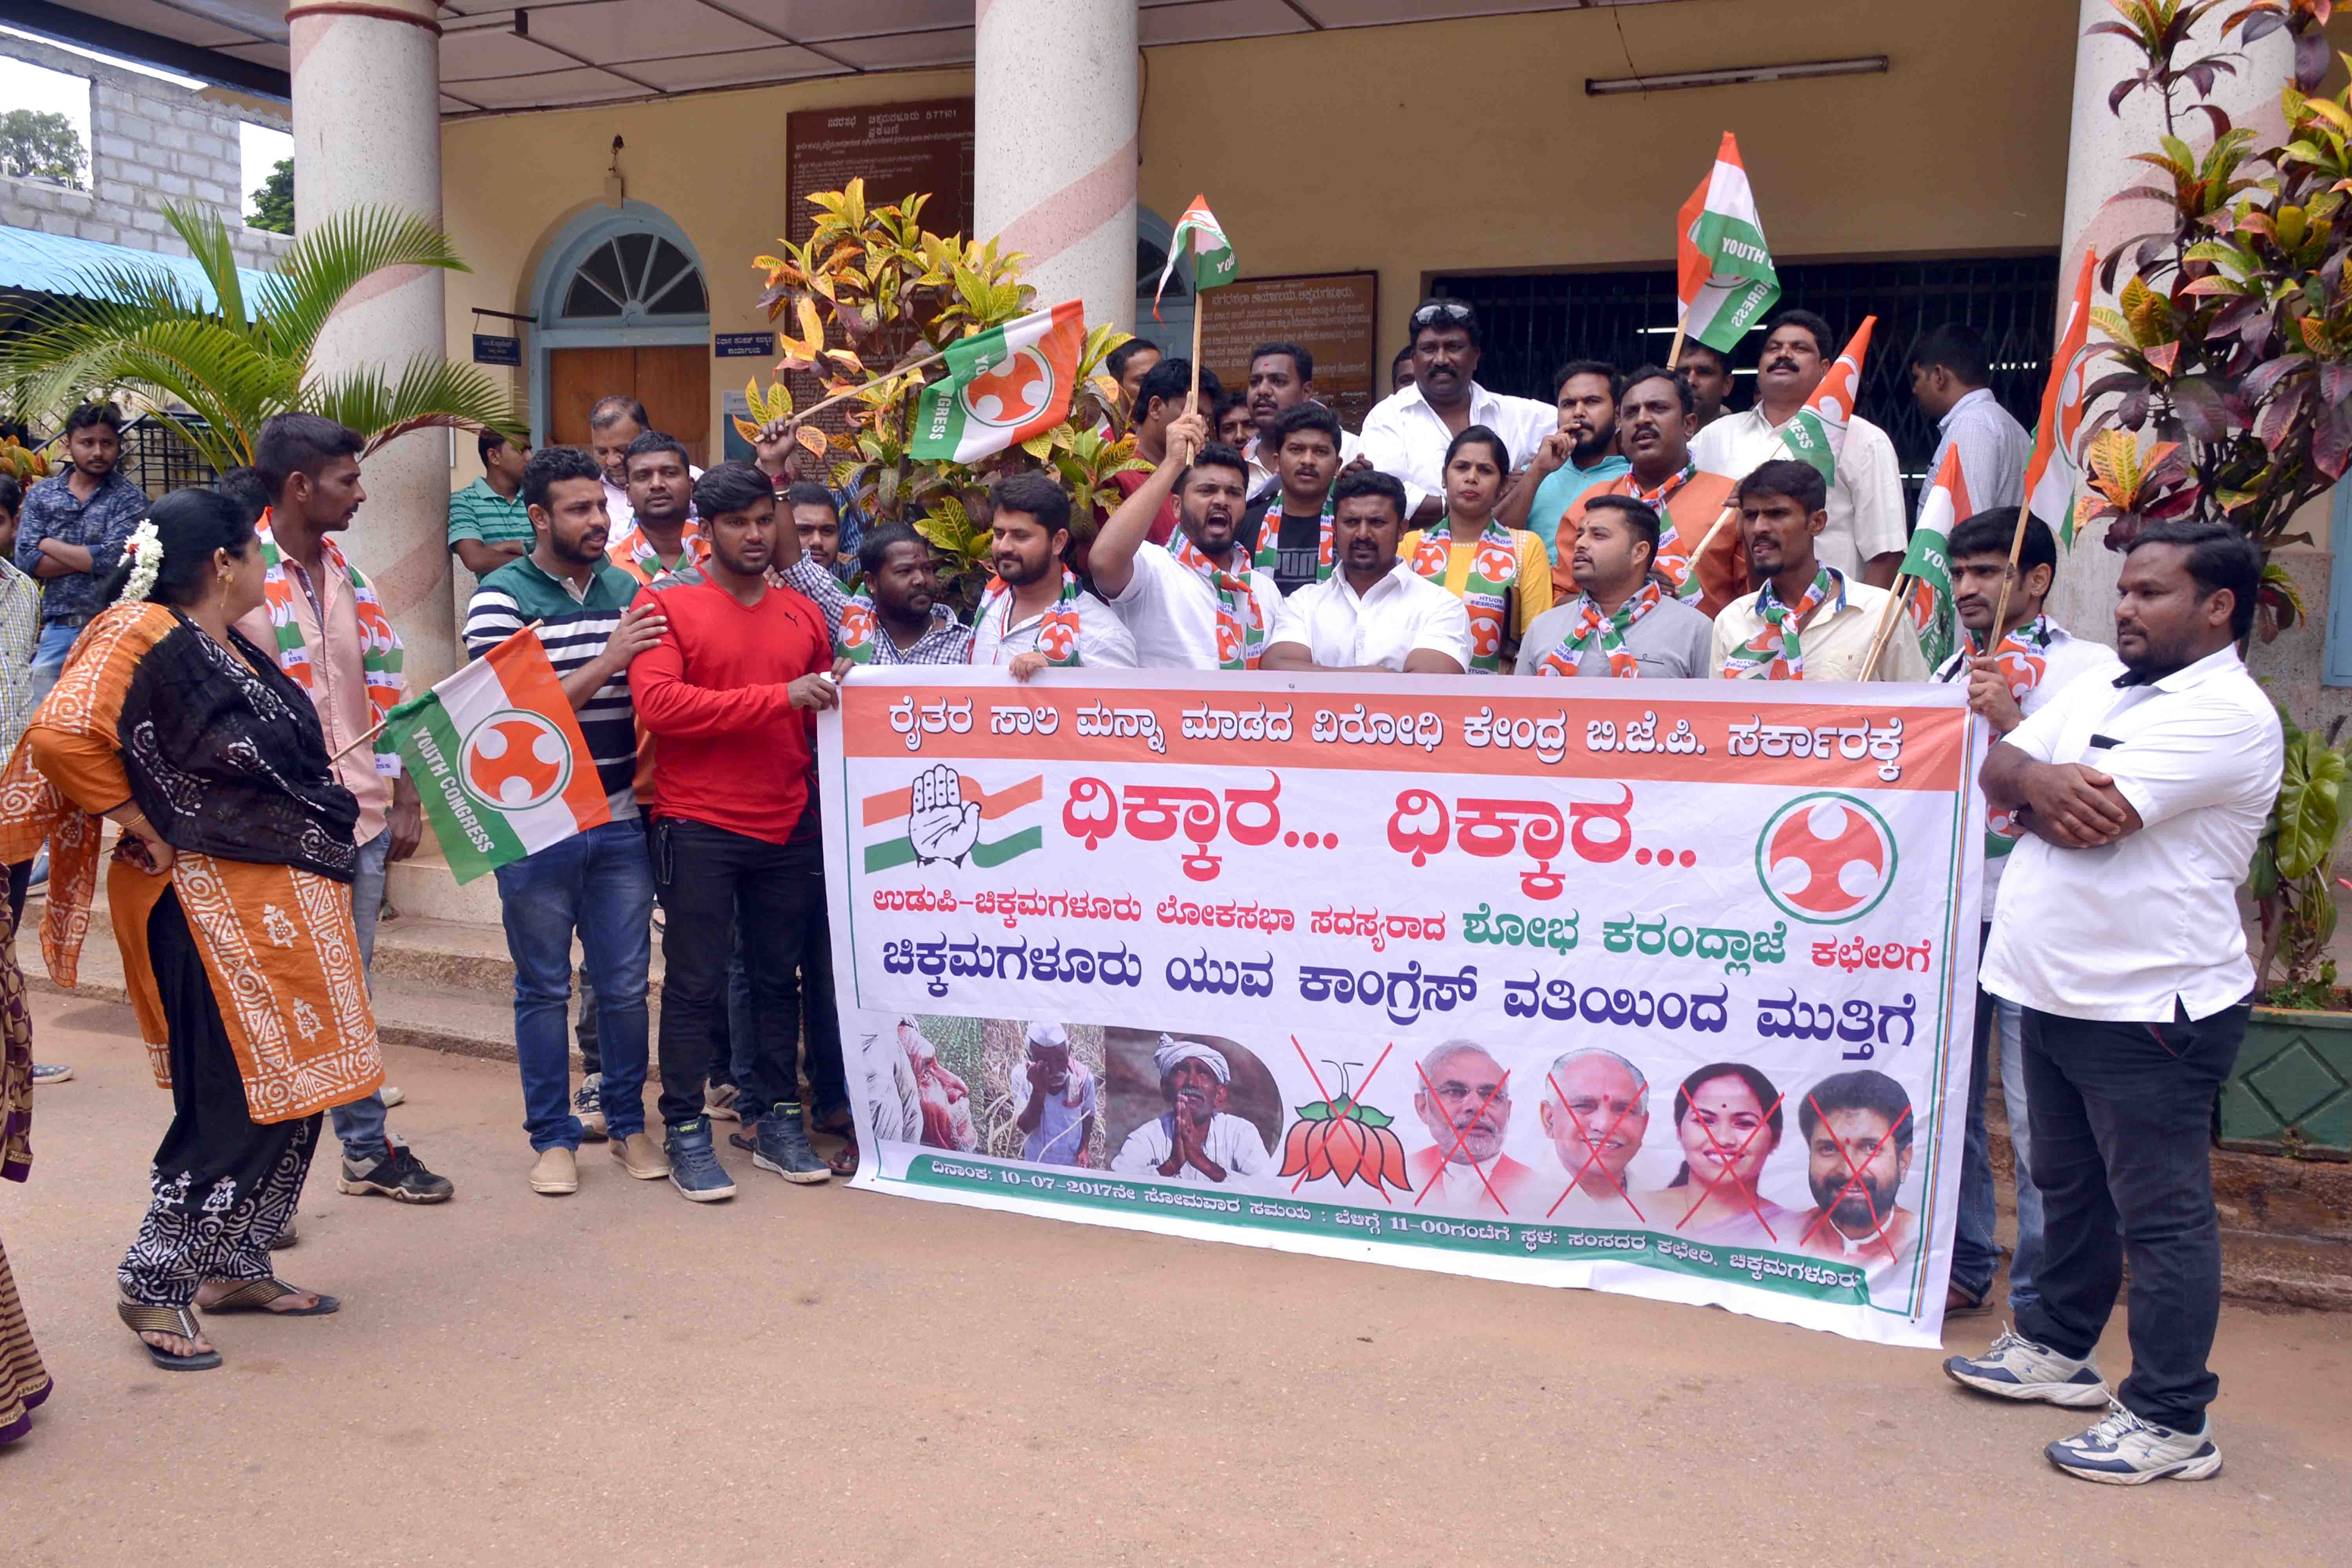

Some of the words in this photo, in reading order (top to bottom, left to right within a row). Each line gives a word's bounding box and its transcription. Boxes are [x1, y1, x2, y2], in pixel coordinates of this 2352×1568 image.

[1722, 237, 1766, 264] YOUTH
[412, 726, 450, 777] YOUTH
[439, 776, 495, 853] CONGRESS
[889, 695, 973, 751] ರೈತರ
[991, 705, 1060, 735] ಸಾಲ
[1076, 698, 1167, 754] ಮನ್ನಾ
[1182, 701, 1294, 742] ಮಾಡದ
[1310, 703, 1444, 753] ವಿರೋಧಿ
[1463, 706, 1567, 764] ಕೇಂದ್ರ
[1586, 710, 1706, 755] ಬಿ.ಜೆ.ಪಿ.
[1728, 714, 1904, 782] ಸರ್ಕಾರಕ್ಕೆ
[1062, 769, 1339, 882] ಧಿಕ್ಕಾರ...
[1387, 782, 1697, 901] ಧಿಕ್ಕಾರ...
[873, 884, 1142, 929] ಉಡುಪಿ-ಚಿಕ್ಕಮಗಳೂರು
[1156, 895, 1295, 935] ಲೋಕಸಭಾ
[1311, 904, 1446, 953] ಸದಸ್ಯರಾದ
[1463, 902, 1580, 956] ಶೋಭ
[1603, 911, 1787, 976] ಕರಂದ್ಲಾಜೆ
[1811, 935, 1931, 973] ಕಛೇರಿಗೆ
[883, 931, 1142, 998] ಚಿಕ್ಕಮಗಳೂರು
[1165, 946, 1274, 998] ಯುವ
[1299, 960, 1477, 1025] ಕಾಂಗ್ರೆಸ್
[1504, 969, 1728, 1033] ವತಿಯಿಂದ
[1757, 987, 1916, 1061] ಮುತ್ತಿಗೆ
[931, 1160, 993, 1181] ದಿನಾಂಕ:
[1000, 1171, 1136, 1200] 10-07-2017ನೇ
[1144, 1188, 1241, 1212] ಸೋಮವಾರ
[1249, 1201, 1312, 1221] ಸಮಯ
[1521, 1229, 1558, 1252] ಸ್ಥಳ:
[1568, 1232, 1646, 1250] ಸಂಸದರ
[1730, 1253, 1861, 1289] ಚಿಕ್ಕಮಗಳೂರು
